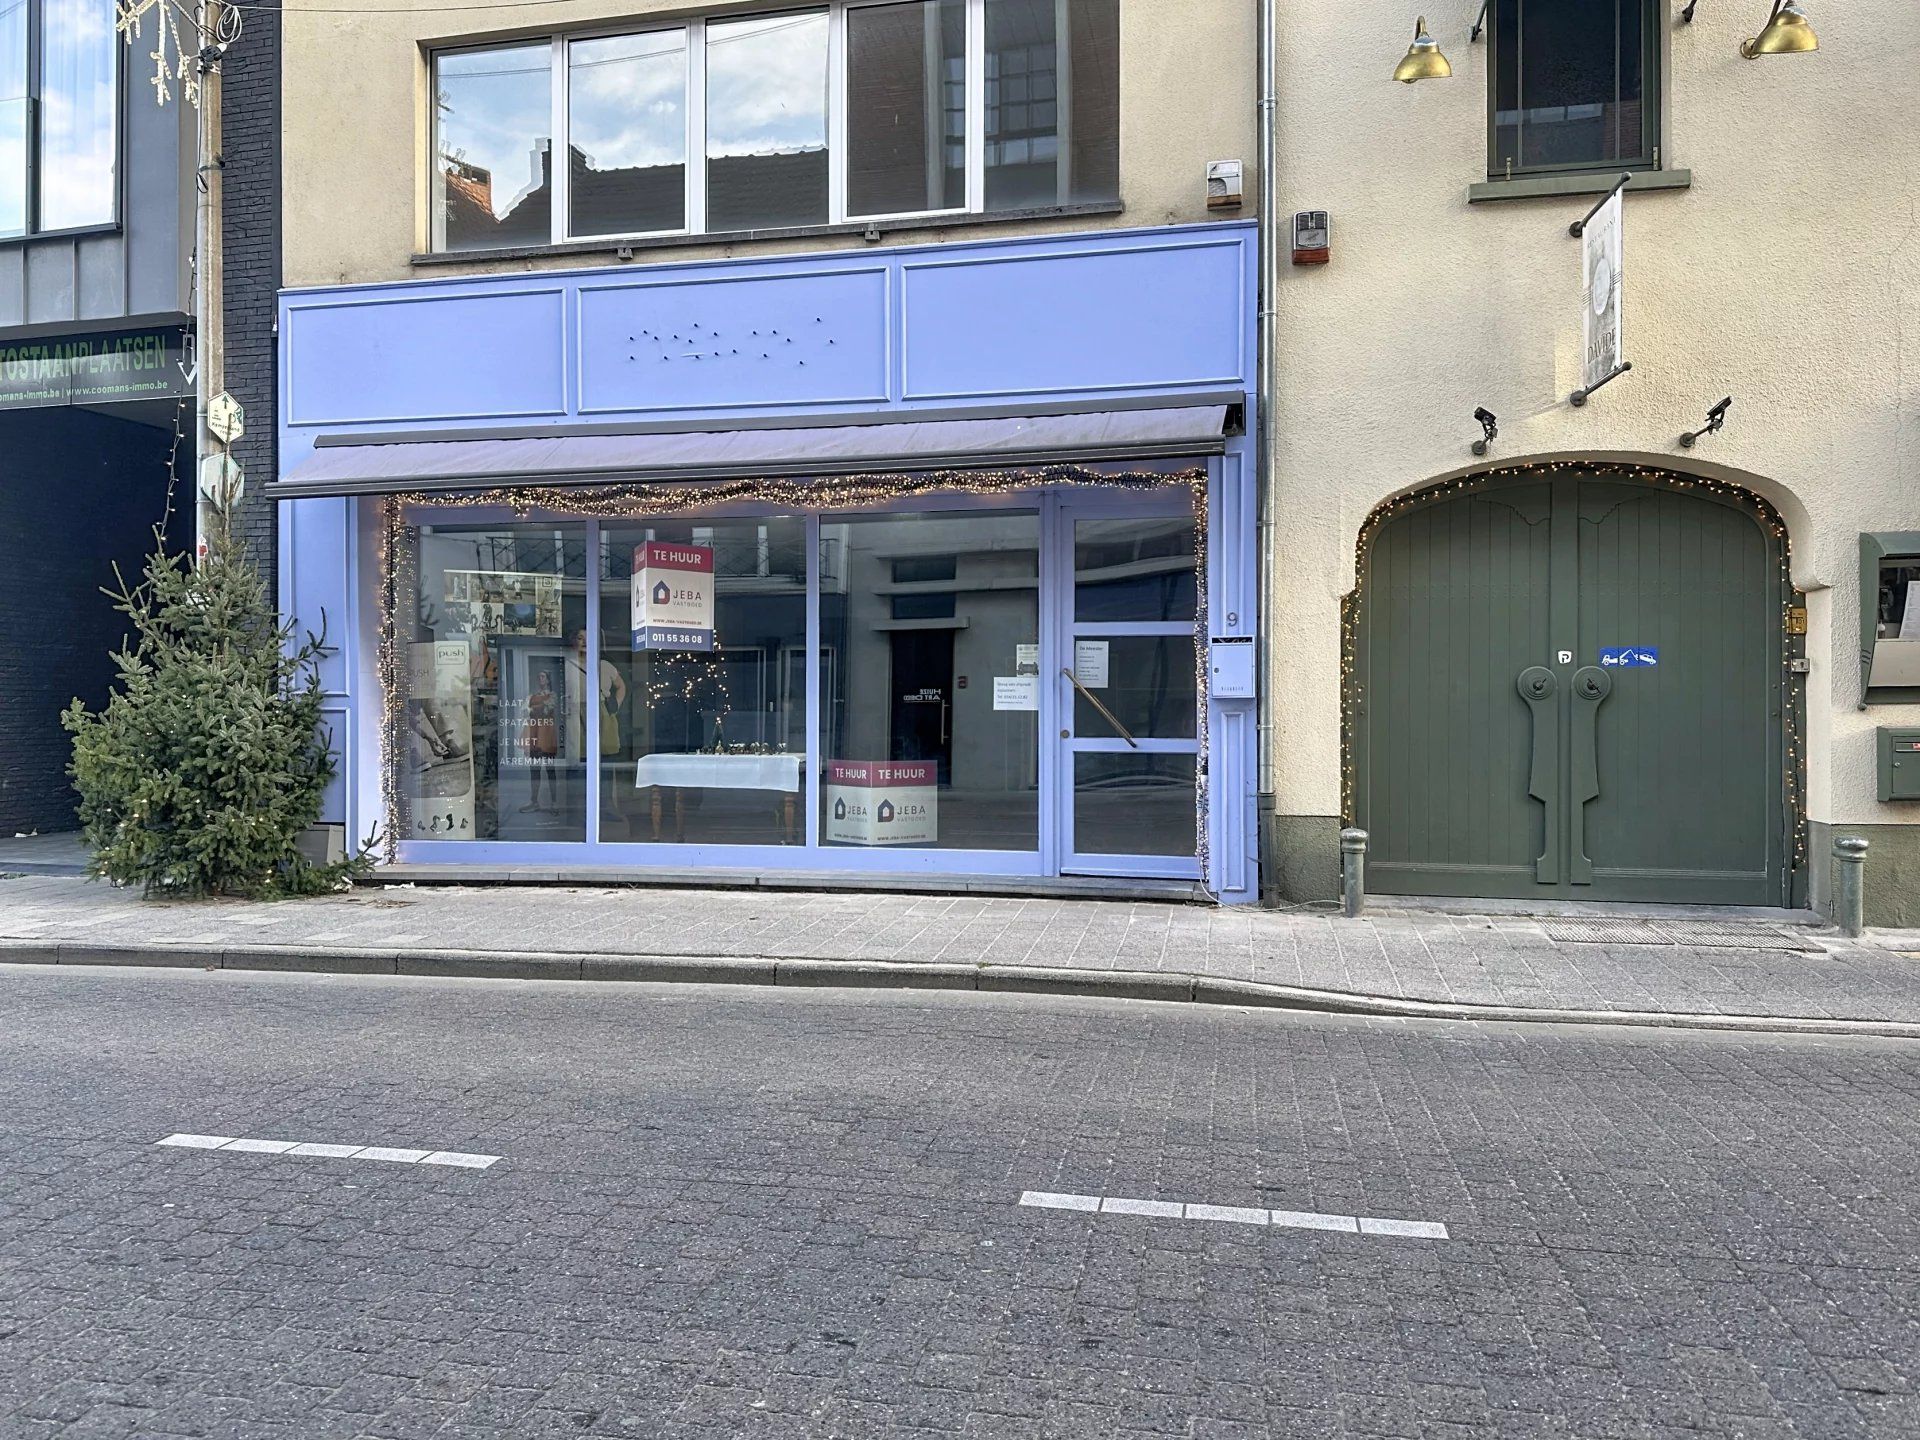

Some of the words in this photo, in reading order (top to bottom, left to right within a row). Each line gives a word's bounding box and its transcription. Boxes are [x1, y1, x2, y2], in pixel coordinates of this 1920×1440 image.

[66, 381, 168, 396] www.coomans-immo.be
[653, 550, 667, 560] TE
[669, 552, 702, 564] HUUR
[673, 590, 702, 601] JEBA
[1227, 612, 1238, 627] 9
[652, 633, 665, 642] 011
[667, 634, 678, 642] 55
[679, 634, 690, 643] 36
[691, 635, 702, 643] 08
[438, 649, 464, 659] push
[499, 699, 524, 707] LAAT
[499, 718, 554, 727] SPATADERS
[499, 737, 510, 746] JE
[513, 737, 538, 746] NIET
[499, 757, 554, 766] AFREMMEN
[835, 768, 844, 778] TE
[845, 768, 867, 779] HUUR
[878, 769, 891, 779] TE
[894, 768, 926, 779] HUUR
[847, 805, 867, 815] JEBA
[897, 805, 926, 815] JEBA
